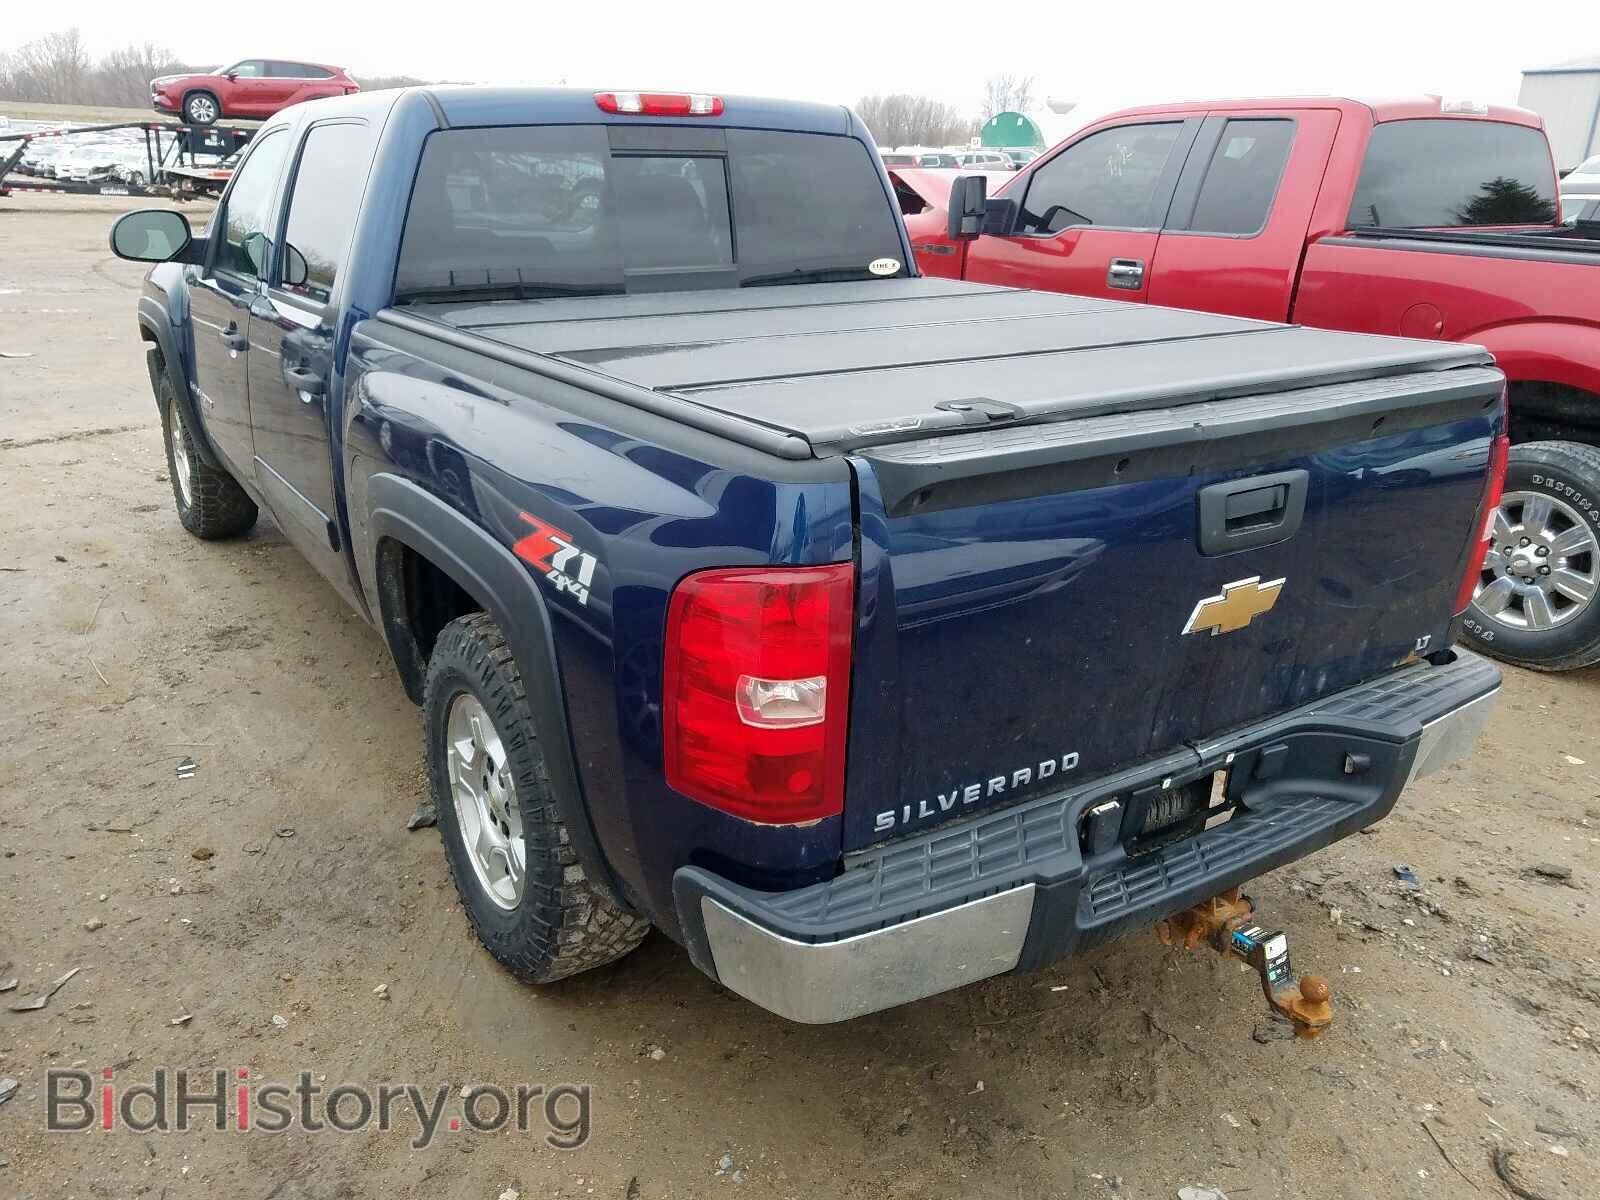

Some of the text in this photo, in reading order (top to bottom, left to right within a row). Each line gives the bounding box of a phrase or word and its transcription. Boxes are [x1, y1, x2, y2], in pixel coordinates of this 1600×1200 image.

[1532, 474, 1600, 530] DESTINA
[512, 511, 597, 587] Z71
[874, 751, 1080, 832] SILVERADO
